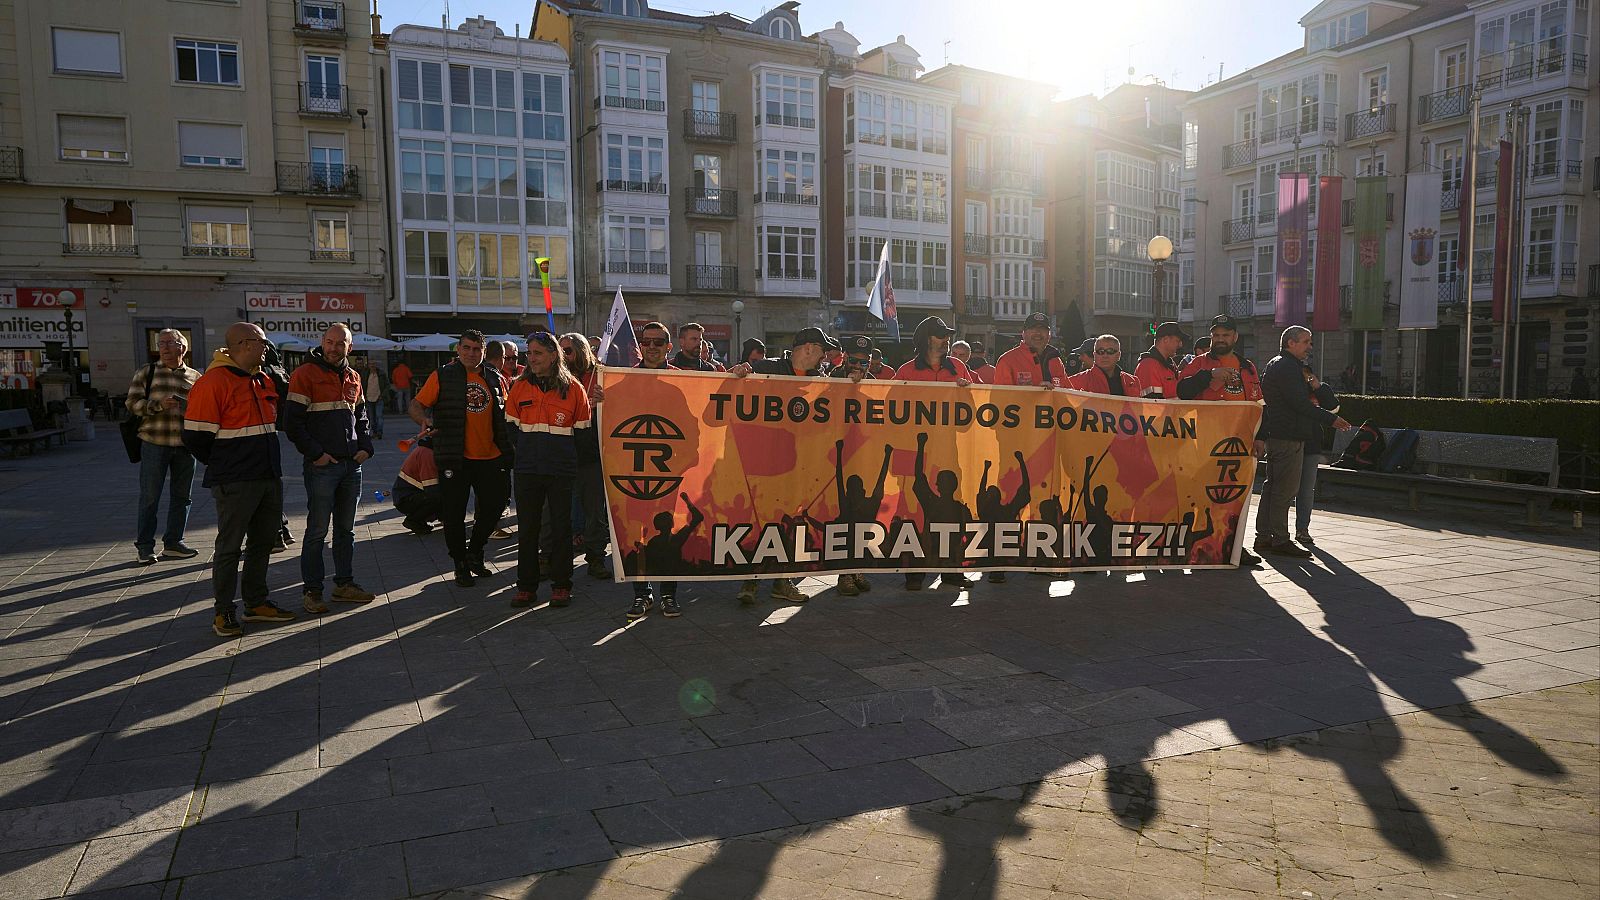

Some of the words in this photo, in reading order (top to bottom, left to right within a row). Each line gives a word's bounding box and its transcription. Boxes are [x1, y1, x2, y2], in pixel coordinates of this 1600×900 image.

[249, 297, 304, 308] OUTLET
[253, 318, 362, 332] dormitiea
[710, 393, 830, 423] TUBOS
[844, 398, 1021, 428] REUNIDOS
[1034, 405, 1198, 440] BORROKAN
[622, 442, 672, 472] TR
[1216, 459, 1241, 482] TR
[713, 521, 1097, 565] KALERATZERIK
[1111, 523, 1189, 557] EZ!!
